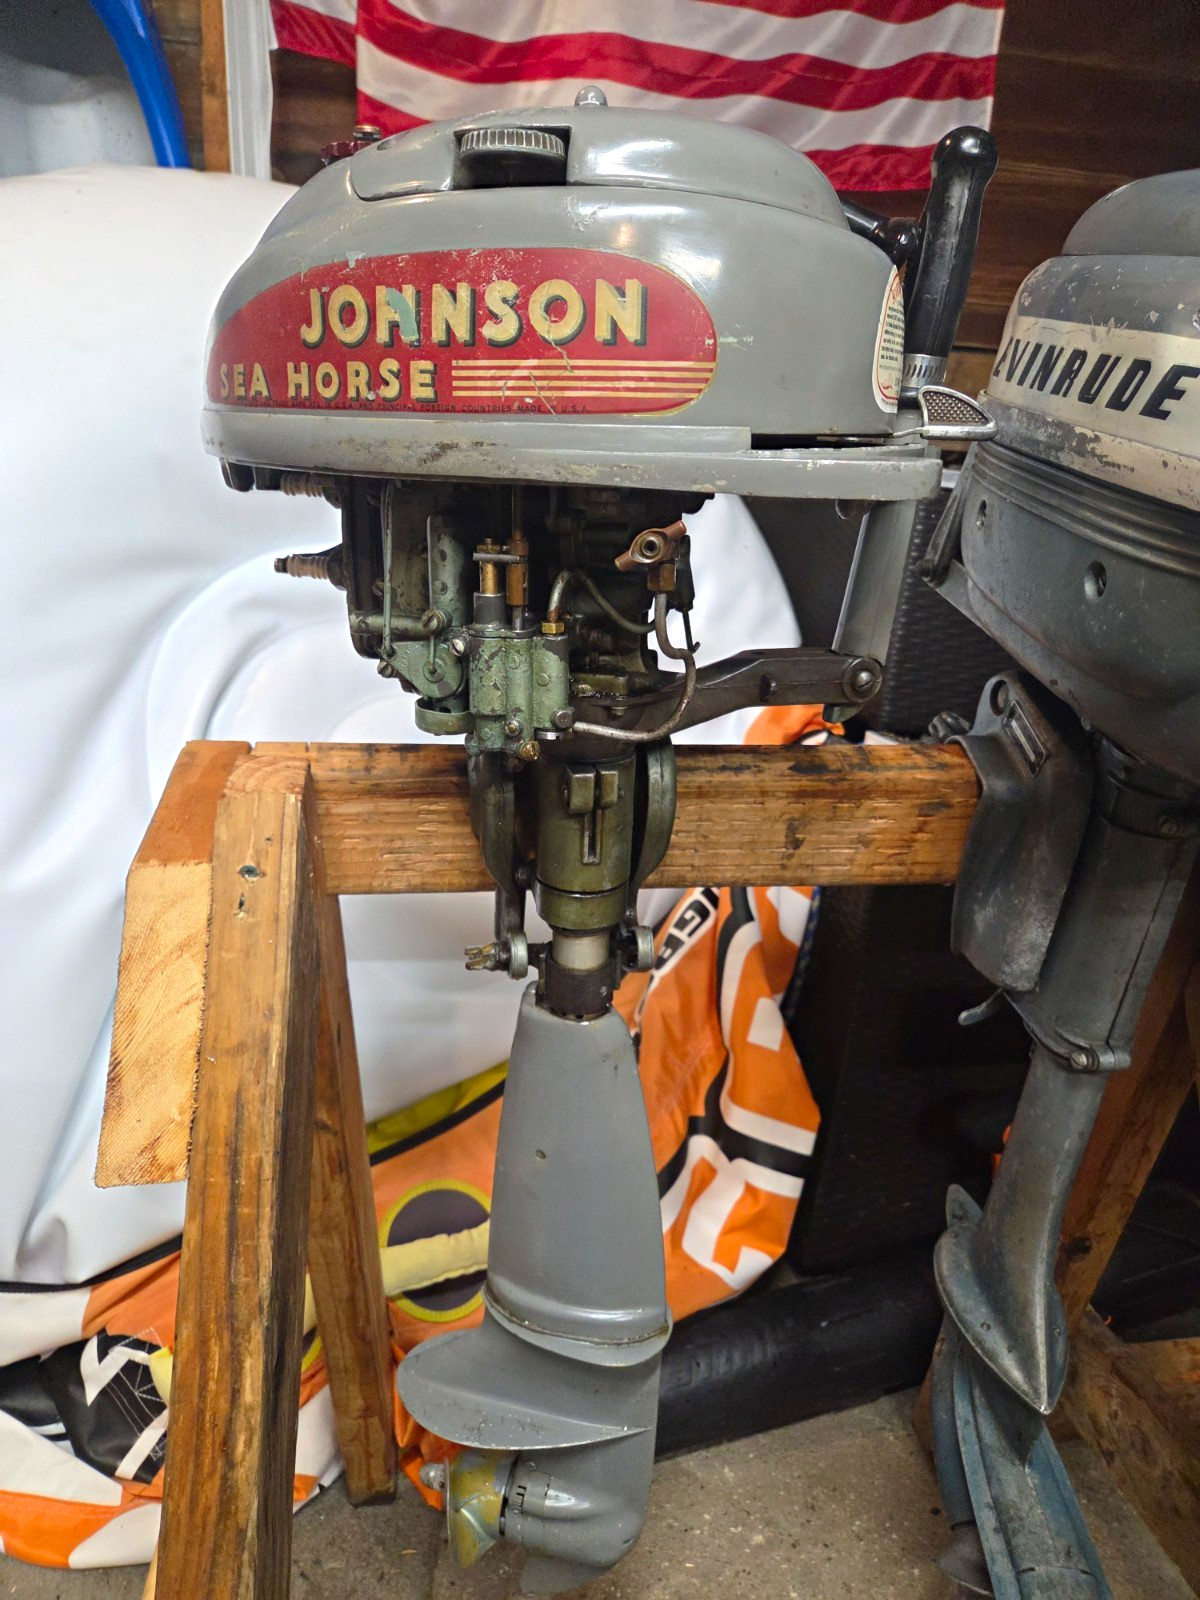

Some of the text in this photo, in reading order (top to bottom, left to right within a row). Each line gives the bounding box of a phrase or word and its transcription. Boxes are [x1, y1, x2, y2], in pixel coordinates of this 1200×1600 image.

[301, 279, 648, 348] JOHNSON
[219, 358, 438, 402] SEA HORSE
[421, 404, 456, 413] FOREIGN
[461, 404, 511, 413] COUNTRIES
[518, 404, 542, 413] MADE
[561, 405, 591, 413] U.S.A.
